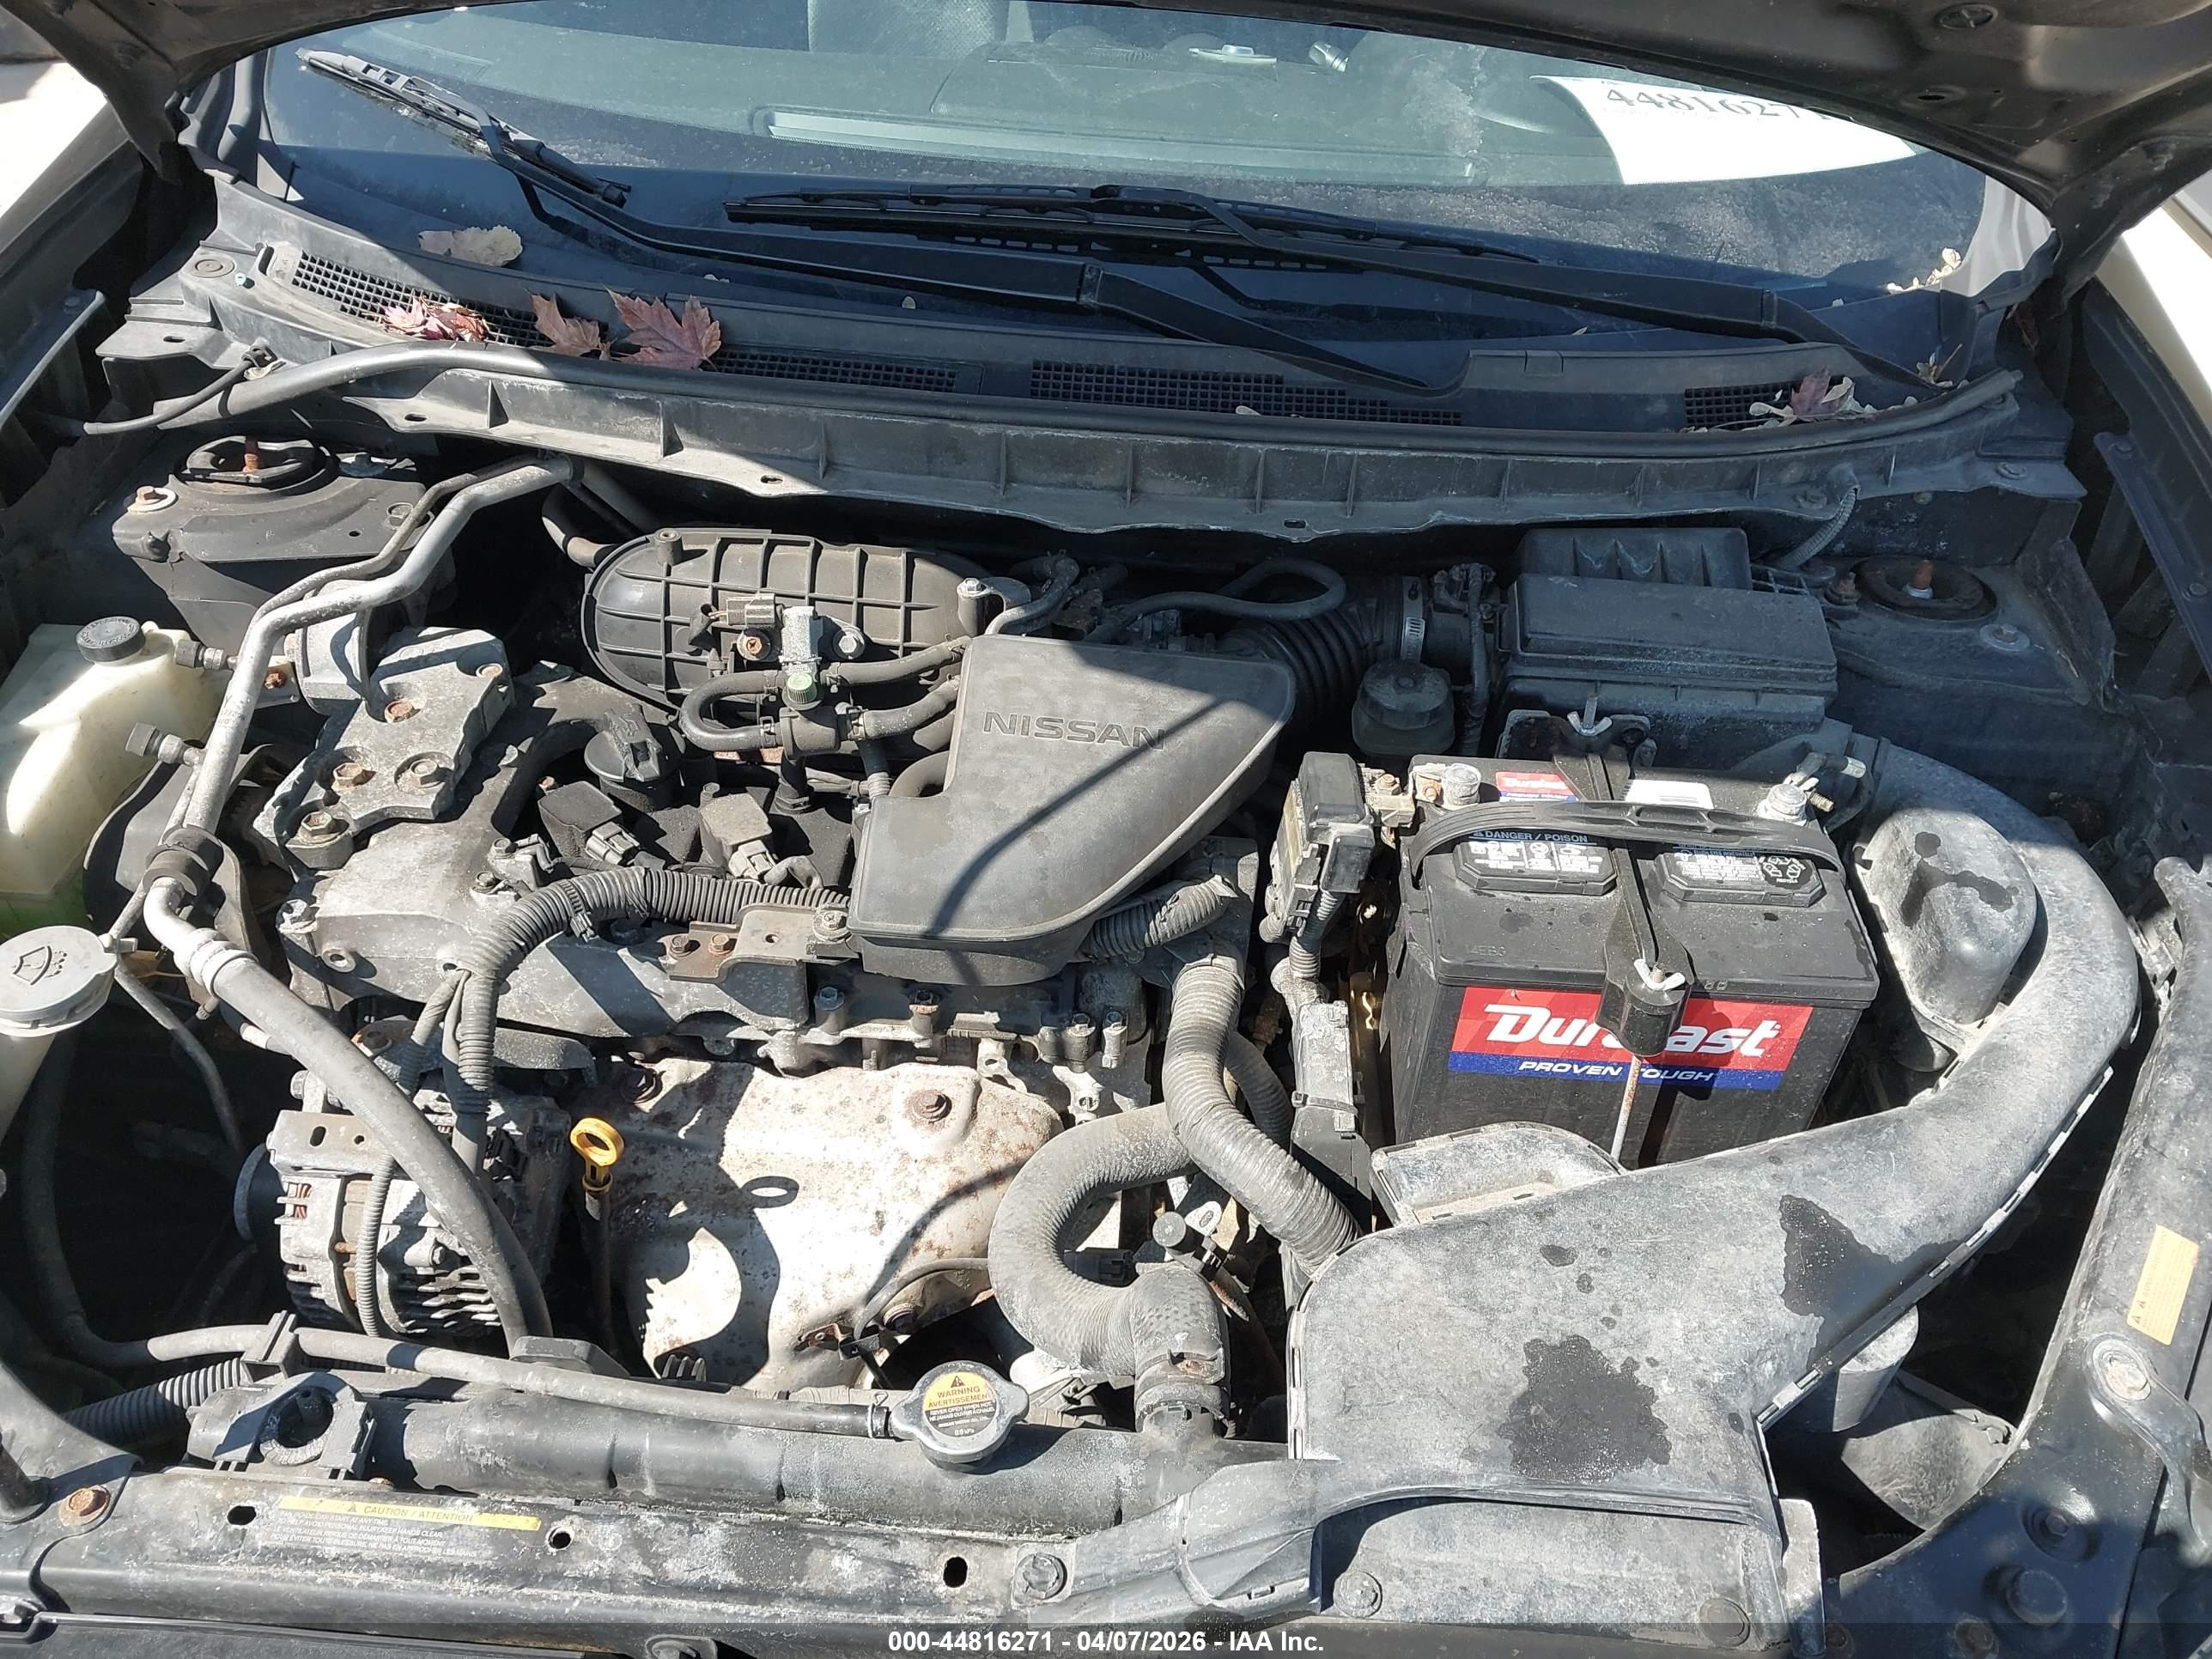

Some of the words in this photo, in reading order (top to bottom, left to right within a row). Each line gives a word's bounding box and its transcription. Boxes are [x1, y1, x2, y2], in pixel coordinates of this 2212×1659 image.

[983, 712, 1166, 750] NISSAN
[1485, 830, 1533, 841] DANGER
[1545, 833, 1589, 842] POISON
[1484, 1002, 1781, 1058] Durast
[1518, 1061, 1623, 1077] PROVEN
[1639, 1066, 1716, 1082] OUGH
[937, 1386, 981, 1399] WARNING
[927, 1394, 992, 1408] AVERTISSEMEN
[948, 1405, 963, 1414] OPEN
[963, 1403, 980, 1412] WHEN
[363, 1505, 410, 1517] CAUTION
[418, 1510, 474, 1523] ATTENTION
